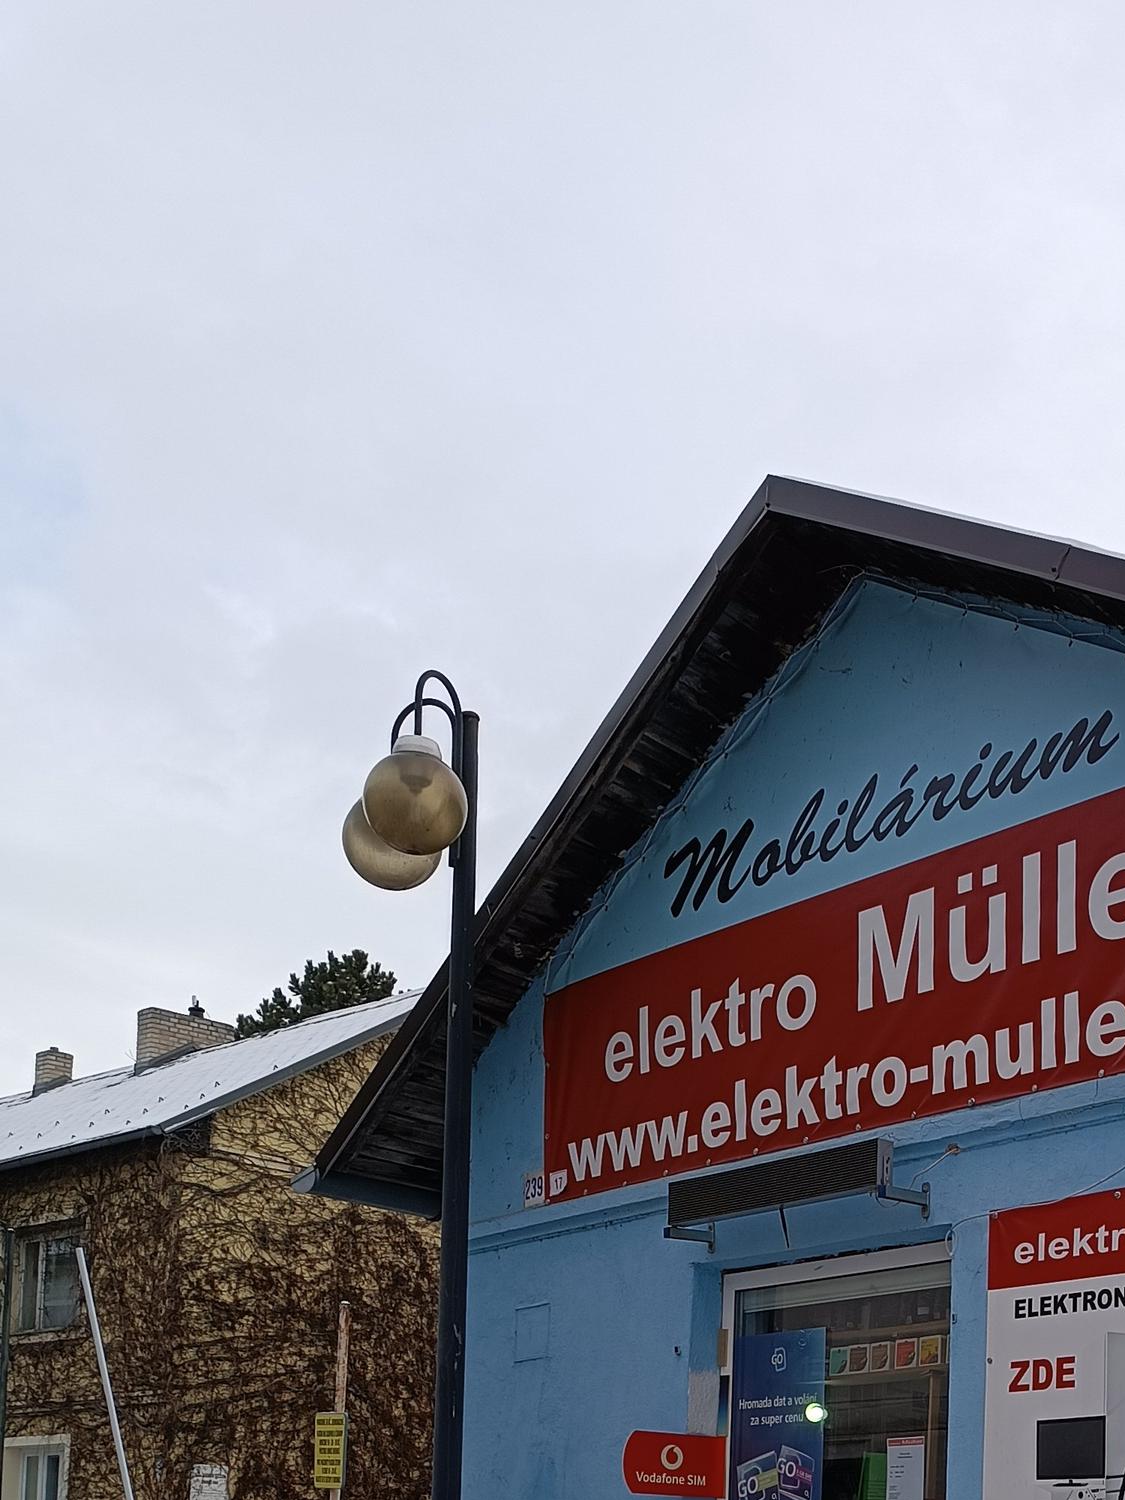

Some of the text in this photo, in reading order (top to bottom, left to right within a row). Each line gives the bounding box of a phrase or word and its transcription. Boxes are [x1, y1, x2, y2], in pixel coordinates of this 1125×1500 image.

[664, 708, 1120, 918] Mobilárium
[604, 974, 817, 1083] elektro
[525, 1175, 543, 1200] 239
[1008, 1356, 1077, 1393] ZDE
[773, 1395, 786, 1407] dat
[750, 1416, 760, 1426] za
[761, 1415, 783, 1427] super
[777, 1458, 796, 1477] GO
[636, 1471, 706, 1487] Vodafone SIM
[738, 1476, 759, 1498] GO
